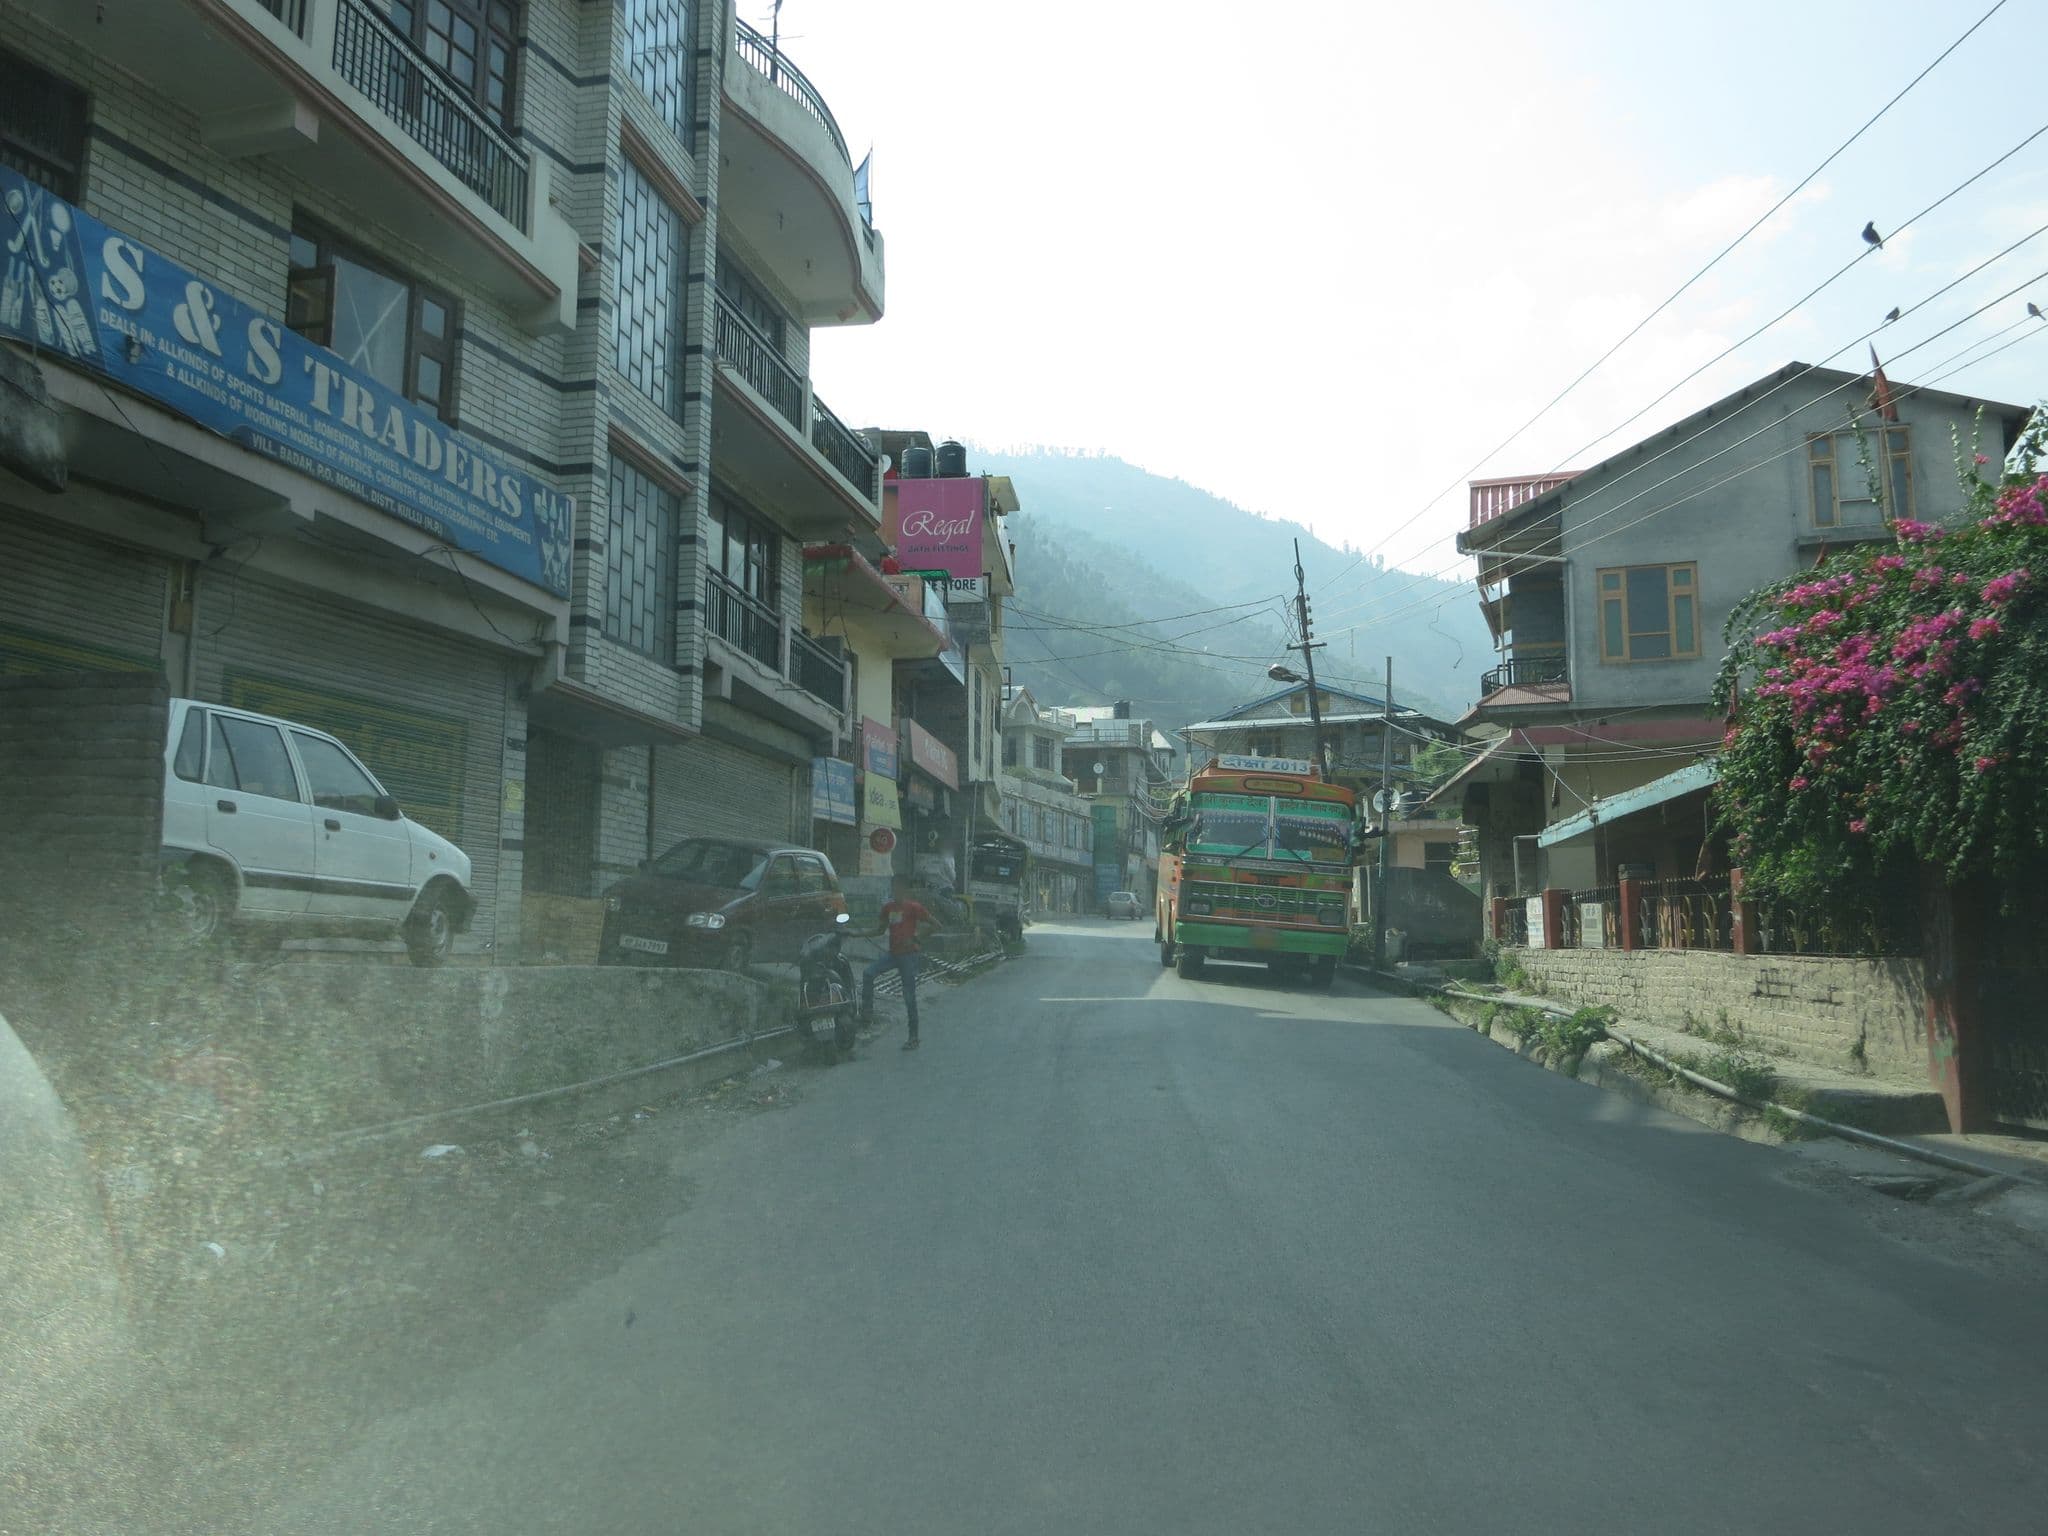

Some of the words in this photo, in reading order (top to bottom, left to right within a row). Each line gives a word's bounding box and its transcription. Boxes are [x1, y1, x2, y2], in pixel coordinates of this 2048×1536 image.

[100, 307, 139, 338] DEALS
[158, 337, 209, 375] ALLKINDS
[211, 365, 226, 382] OF
[227, 374, 265, 405] SPORTS
[102, 237, 145, 311] S
[173, 281, 222, 356] &
[246, 318, 282, 385] S
[304, 355, 522, 518] TRADERS
[166, 361, 176, 379] &
[177, 368, 228, 406] ALLKINDS
[229, 395, 243, 414] OF
[244, 404, 288, 437] WORKING
[289, 425, 325, 455] MODELS
[326, 444, 338, 460] OF
[397, 503, 423, 525] KULLU
[903, 510, 975, 545] Regal
[1271, 760, 1308, 773] 2013
